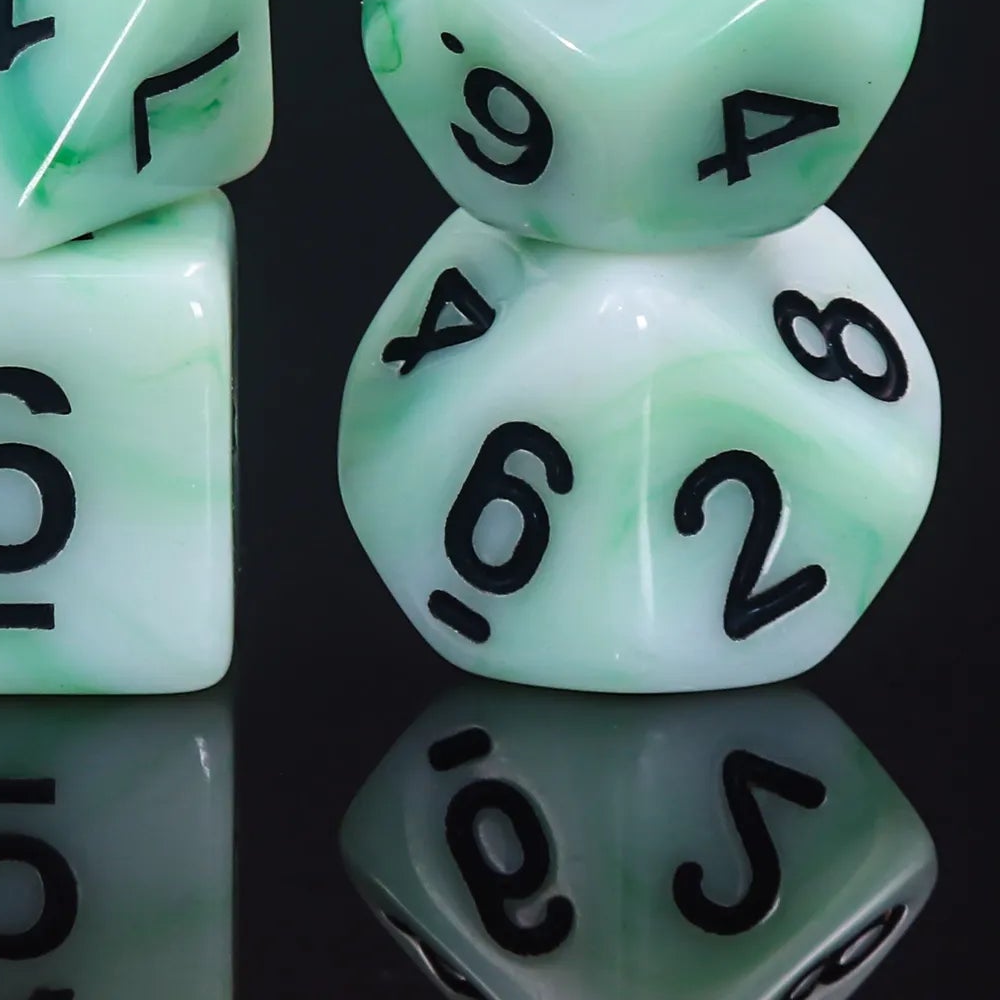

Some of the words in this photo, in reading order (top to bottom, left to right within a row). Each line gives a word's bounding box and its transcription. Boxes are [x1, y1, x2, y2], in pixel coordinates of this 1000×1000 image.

[133, 30, 239, 174] 7
[693, 86, 840, 187] 4
[381, 267, 497, 380] 4
[776, 290, 908, 402] 8
[673, 450, 827, 641] 2
